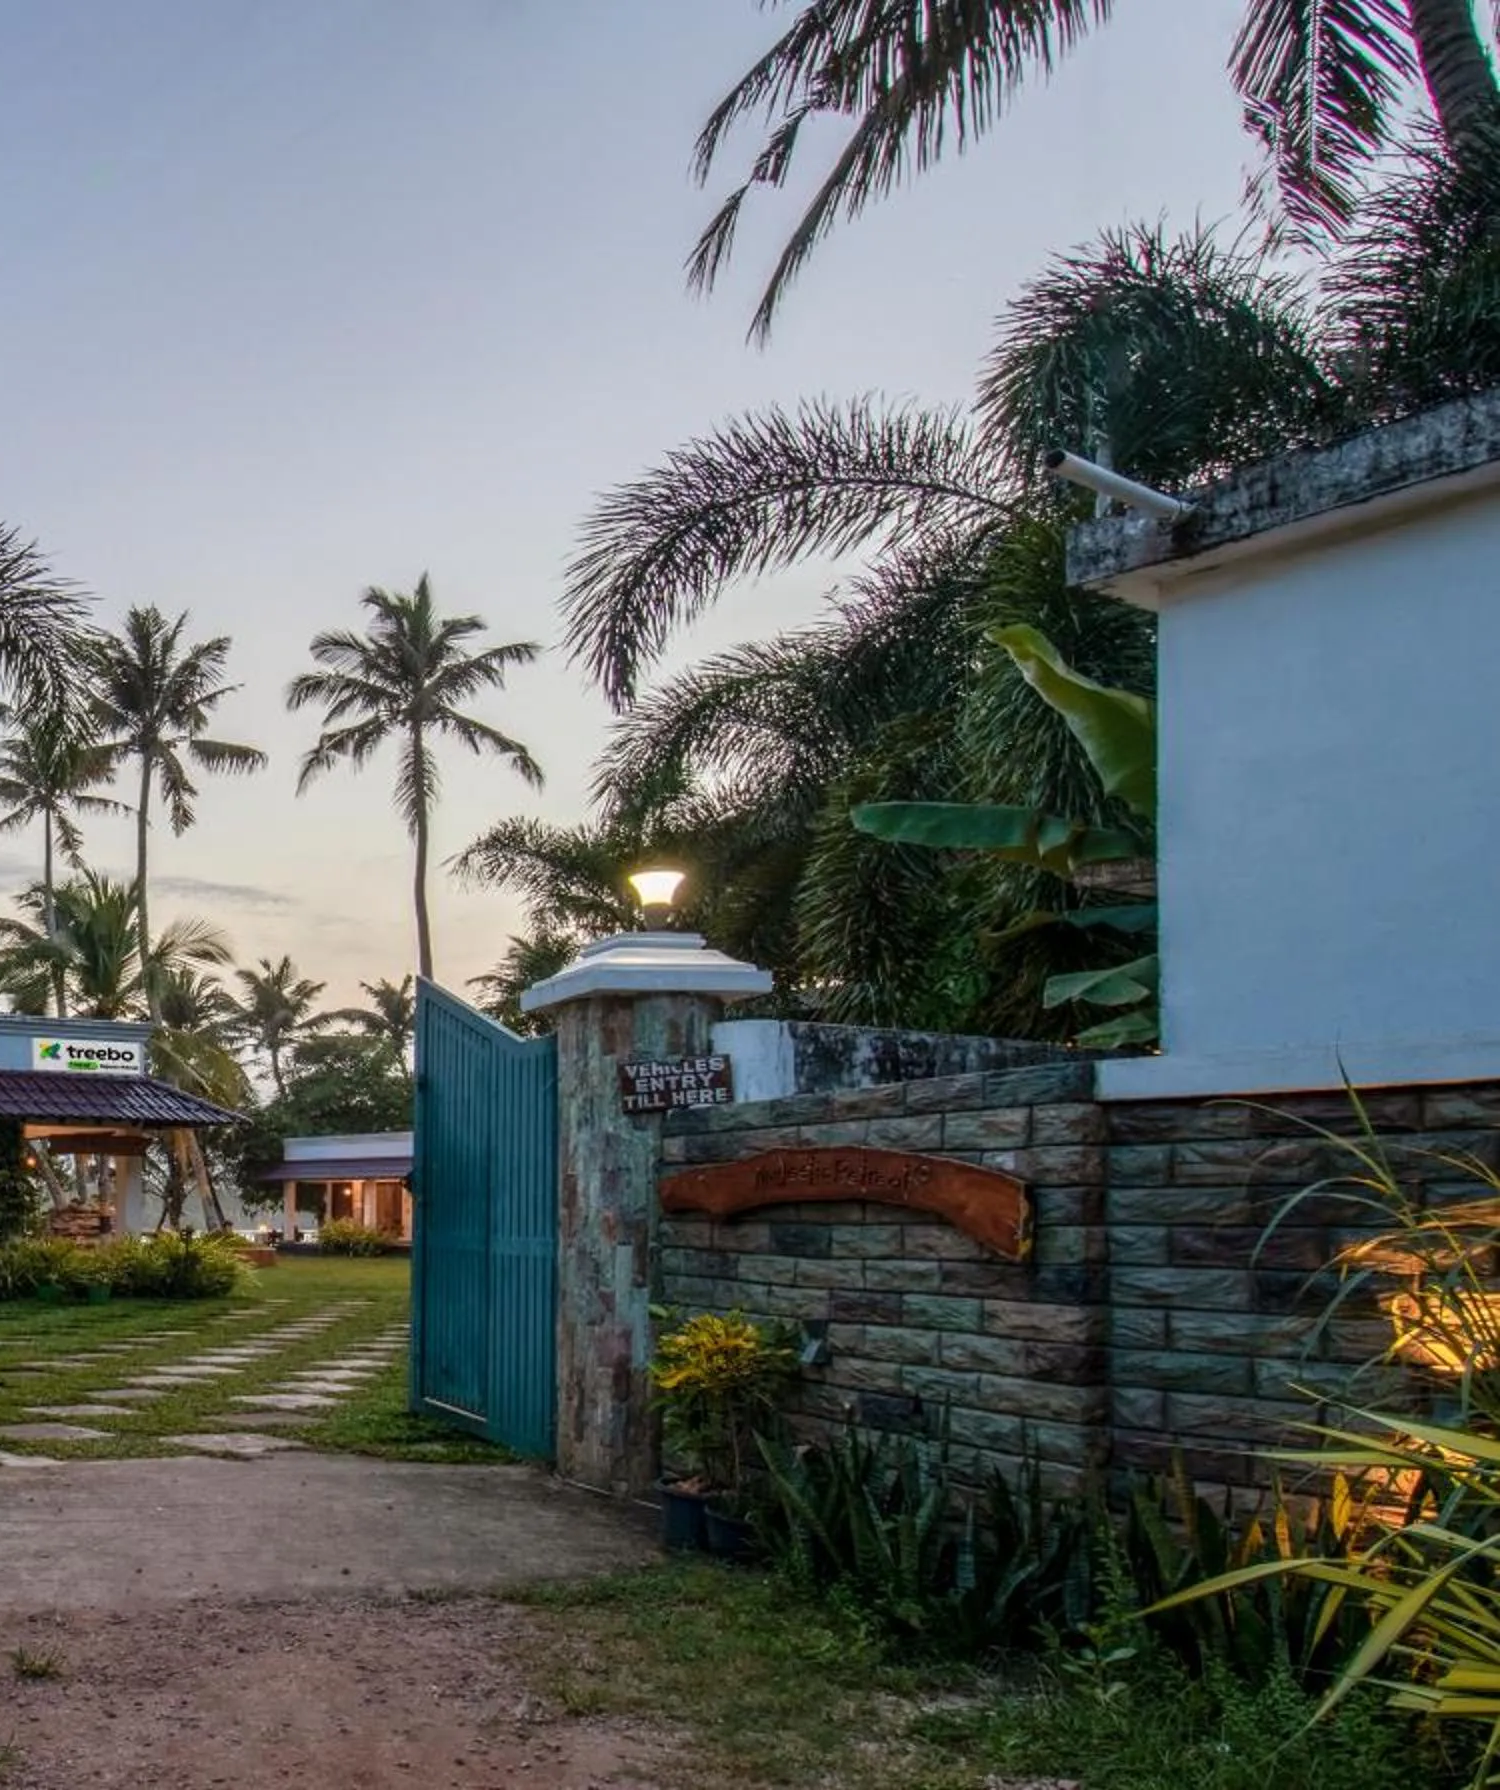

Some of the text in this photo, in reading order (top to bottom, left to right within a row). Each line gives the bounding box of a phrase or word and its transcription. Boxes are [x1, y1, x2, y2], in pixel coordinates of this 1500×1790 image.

[66, 1045, 134, 1062] treebo
[624, 1057, 725, 1079] VEHICLES
[635, 1072, 714, 1093] ENTRY
[623, 1087, 728, 1110] TILL HERE
